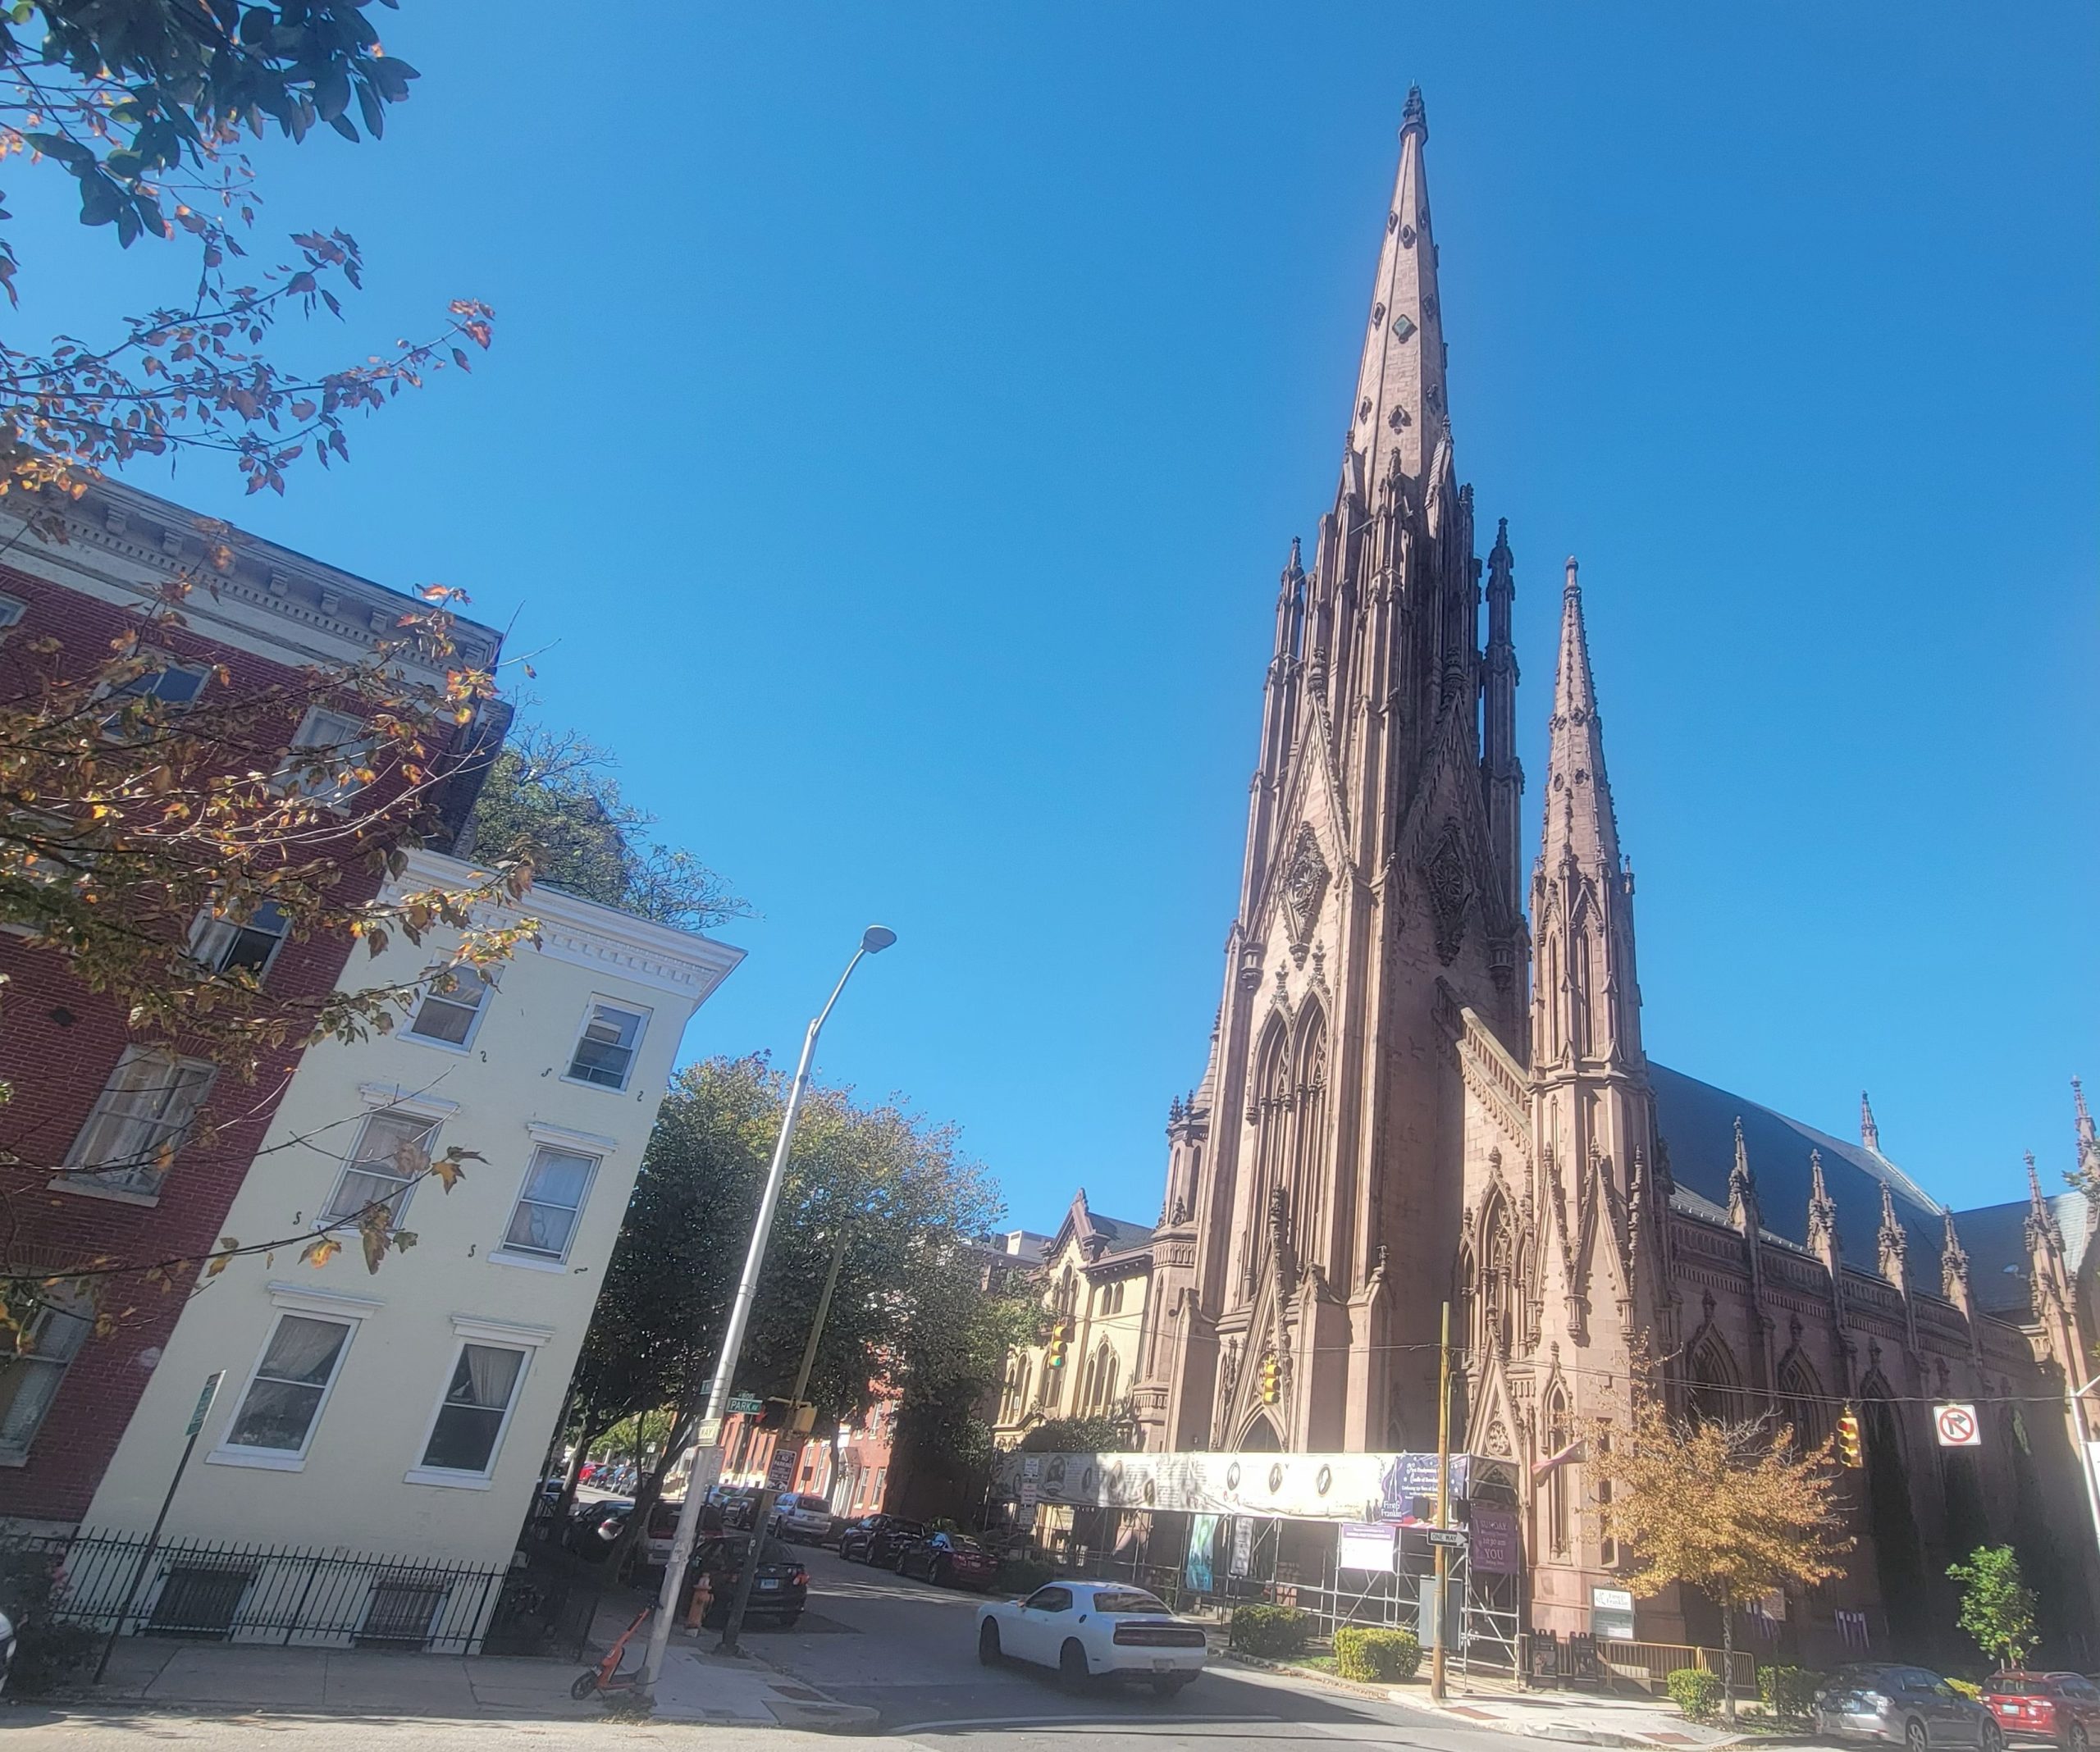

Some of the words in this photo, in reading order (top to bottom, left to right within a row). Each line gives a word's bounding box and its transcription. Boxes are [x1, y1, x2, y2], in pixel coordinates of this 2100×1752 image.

[730, 1401, 752, 1412] PARK
[1381, 1508, 1402, 1517] Franklin
[1481, 1520, 1507, 1531] SUNDAY
[1484, 1548, 1504, 1560] YOU
